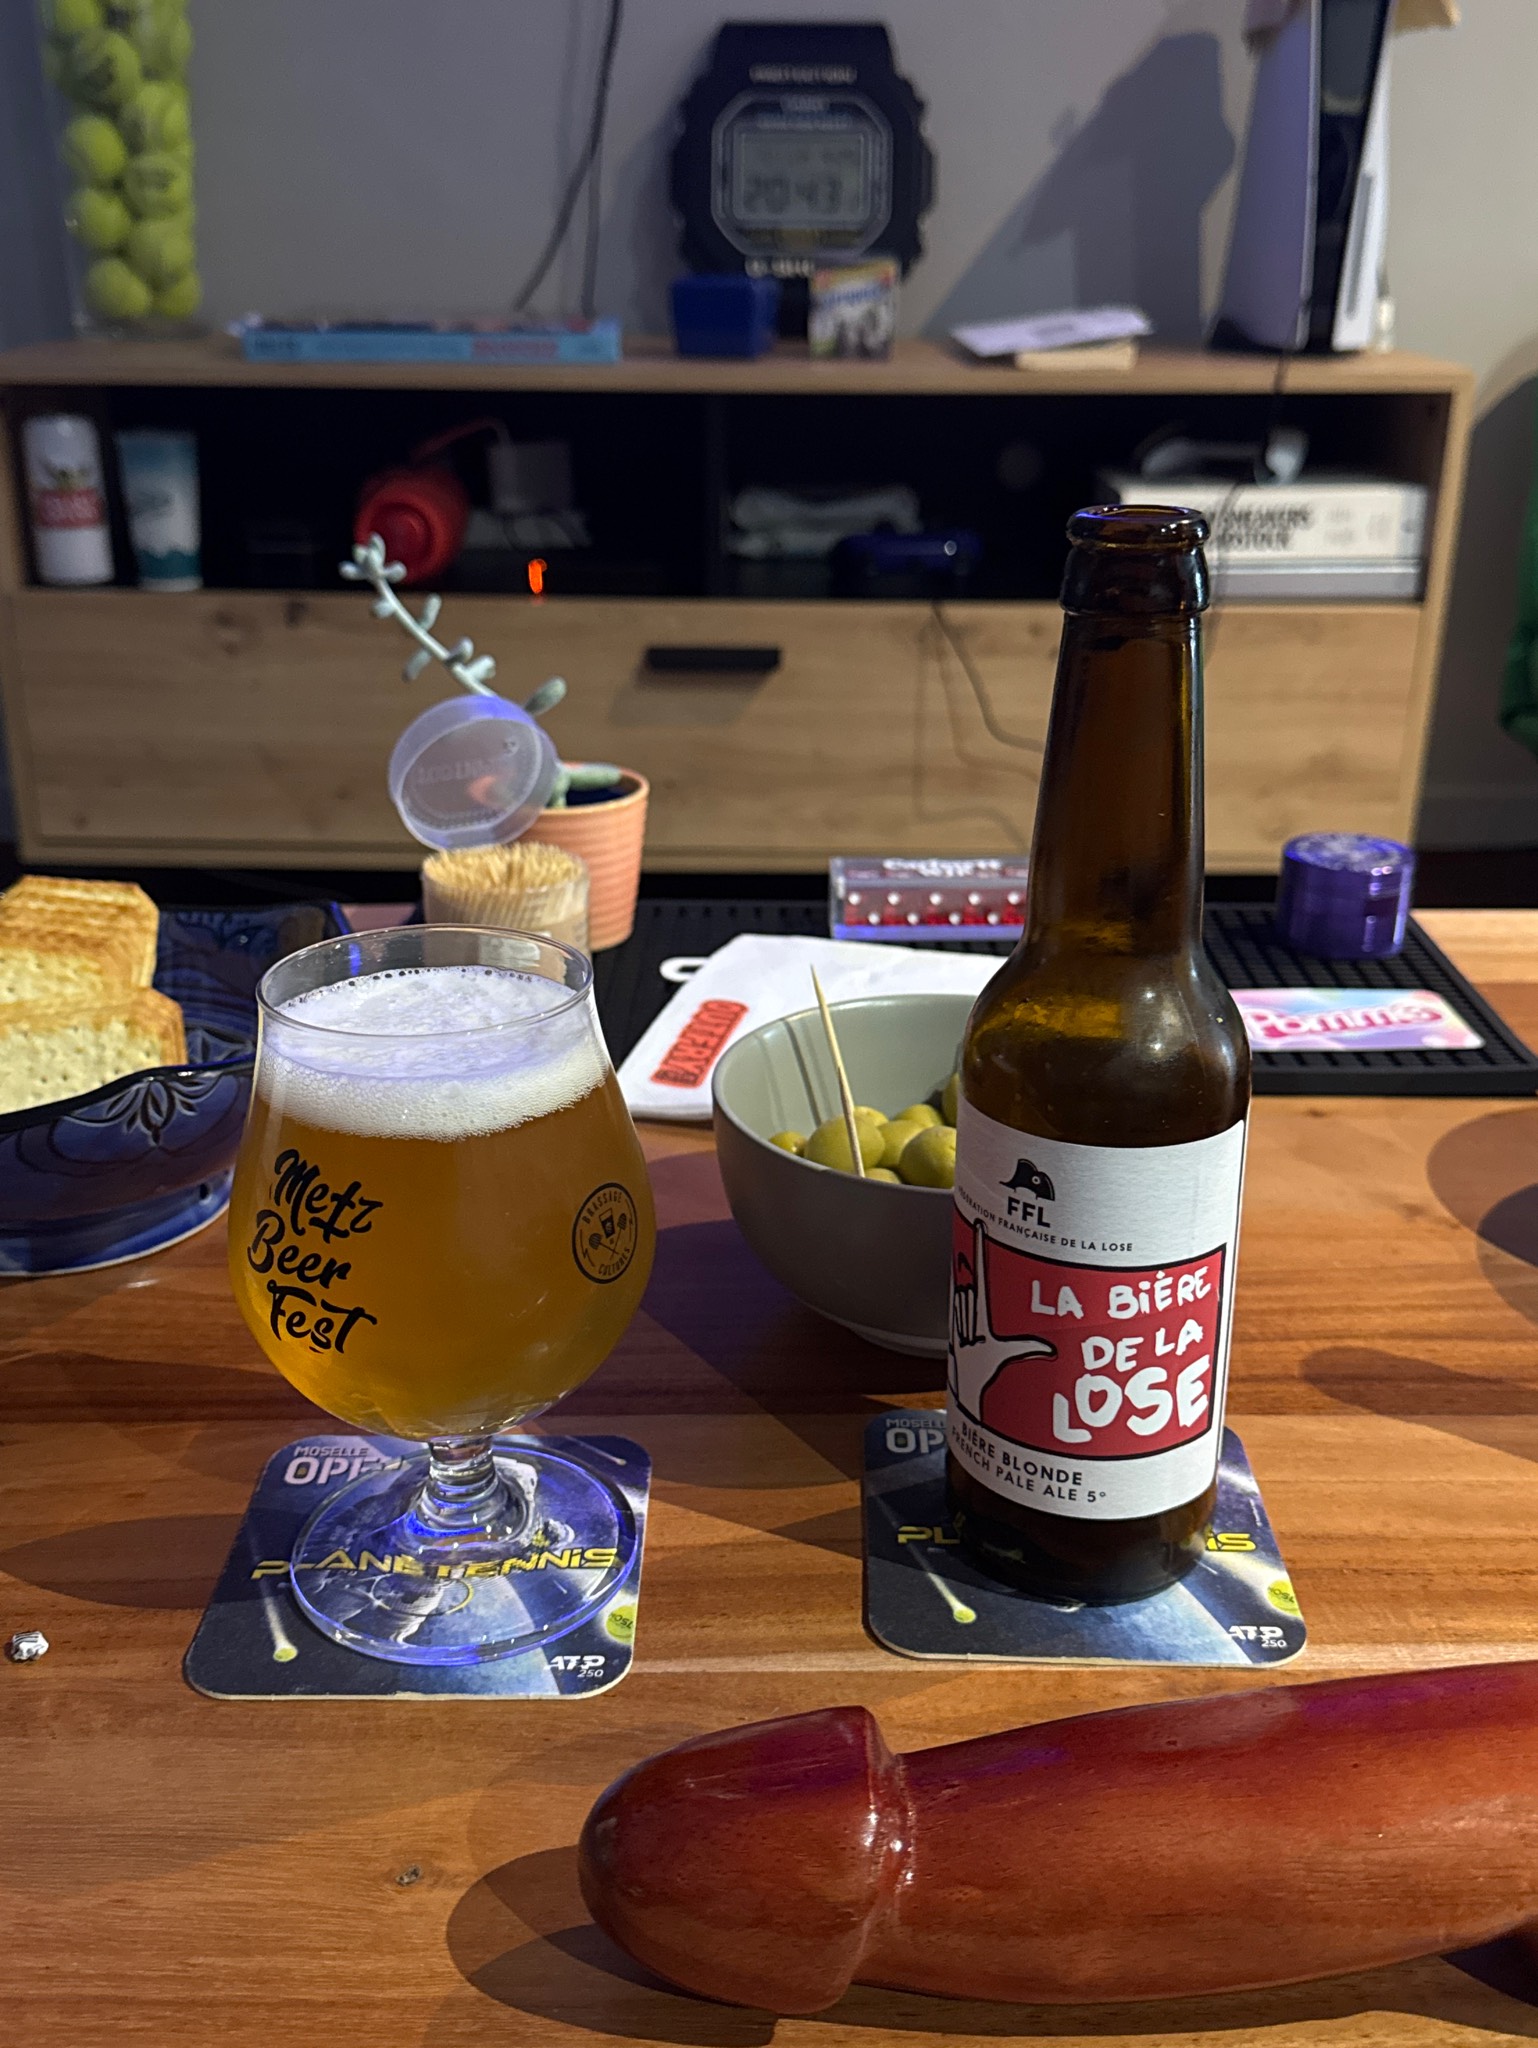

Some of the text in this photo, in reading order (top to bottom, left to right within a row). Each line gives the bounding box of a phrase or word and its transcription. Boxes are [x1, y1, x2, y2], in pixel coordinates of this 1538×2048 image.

[274, 1148, 384, 1244] Metz
[1007, 1196, 1051, 1228] FFL
[958, 1185, 1134, 1253] ÉDÉRATION FRANÇAISE DE LA LOSE
[247, 1209, 352, 1289] Beer
[1031, 1279, 1084, 1320] LA
[1080, 1318, 1204, 1373] DE LA
[1053, 1354, 1210, 1442] LOSE
[885, 1418, 948, 1429] MOSELL
[294, 1446, 369, 1457] MOSELLE
[951, 1425, 991, 1472] FRENCH
[995, 1464, 1035, 1492] PALE
[1043, 1484, 1078, 1501] ALE
[961, 1421, 1083, 1486] BIÈRE BLONDE
[1227, 1625, 1284, 1641] ATP
[1261, 1639, 1287, 1649] 250
[543, 1655, 606, 1671] ATP
[576, 1669, 604, 1678] 250
